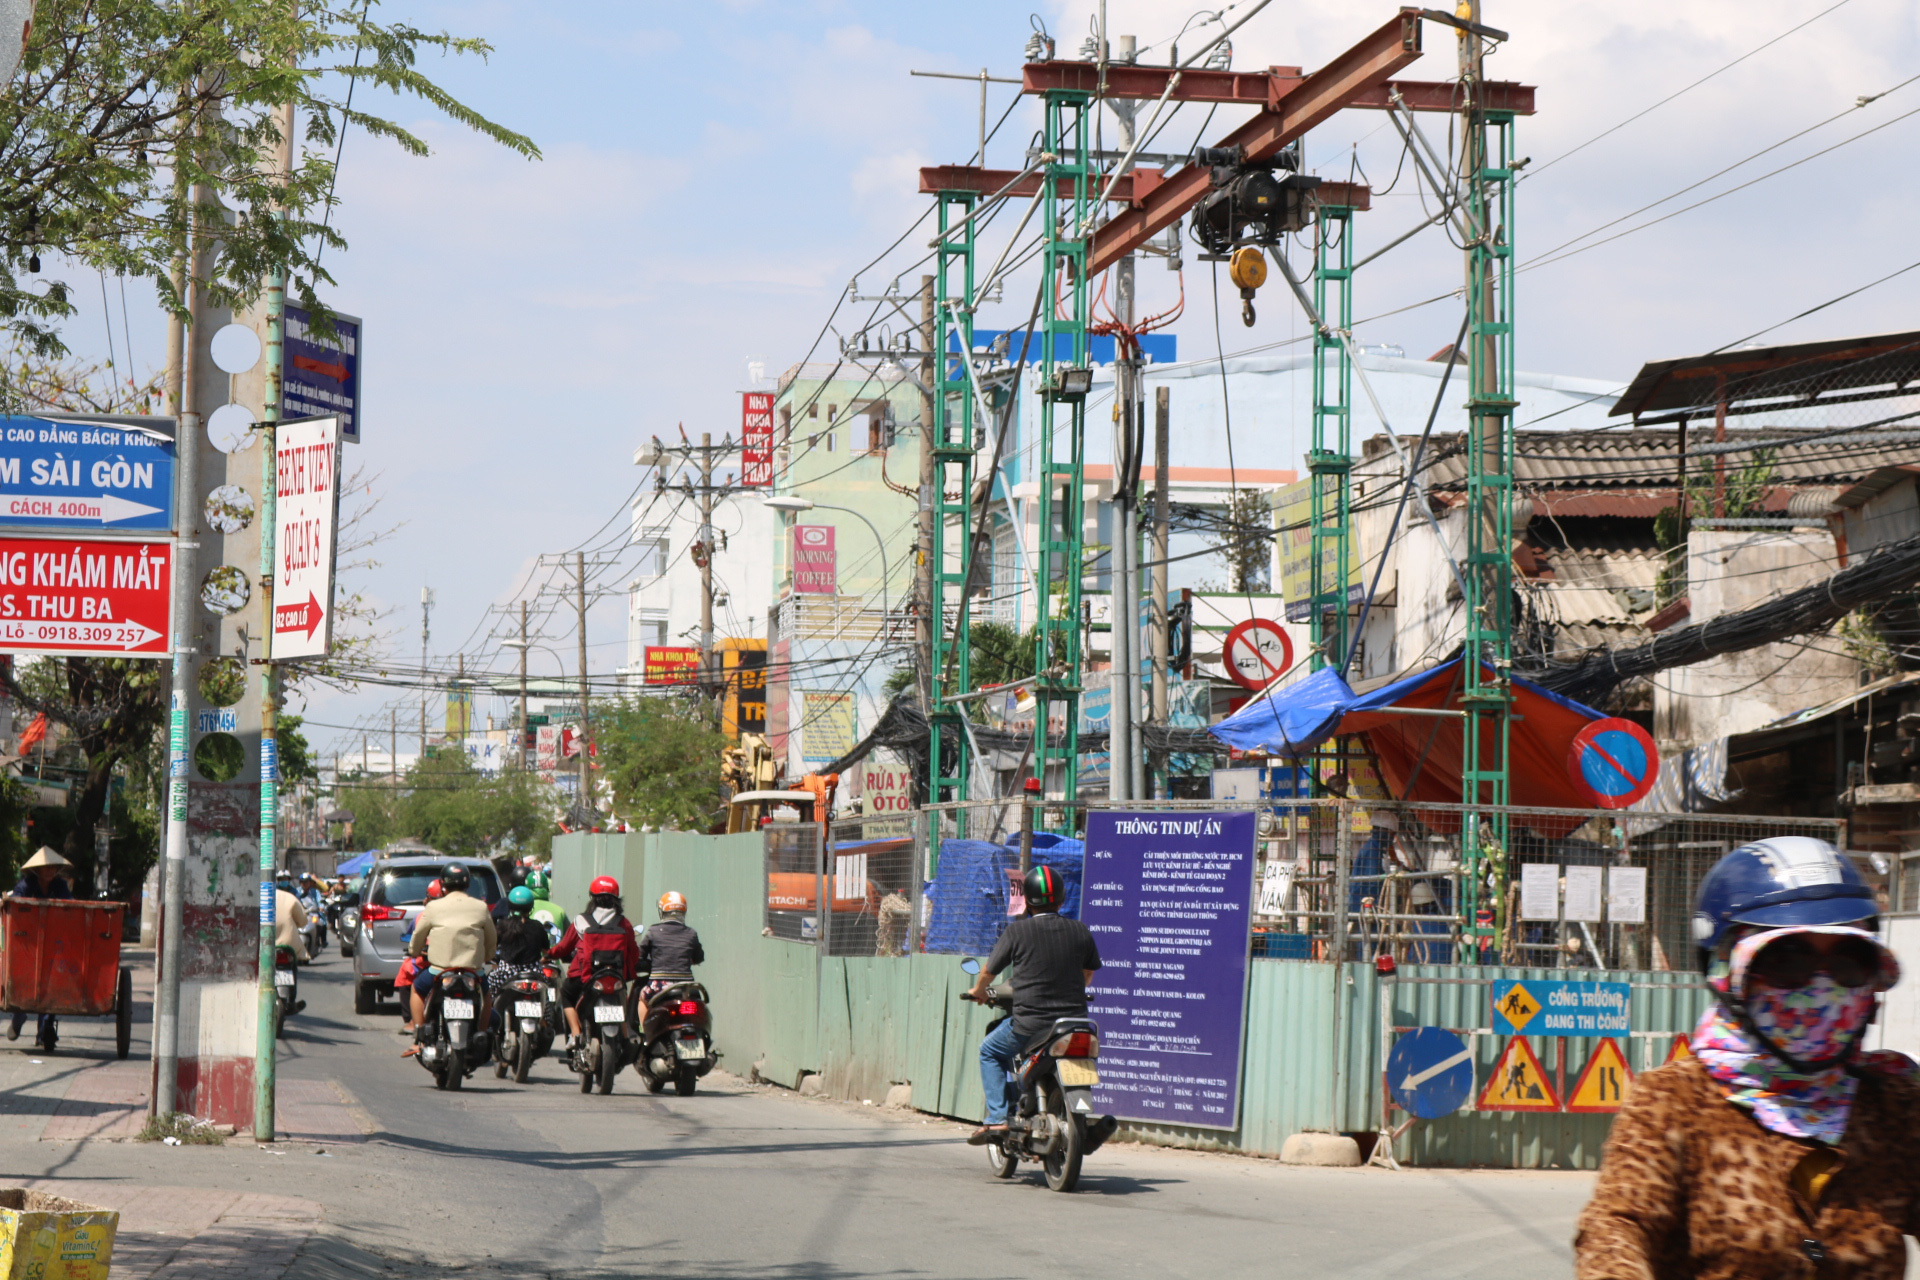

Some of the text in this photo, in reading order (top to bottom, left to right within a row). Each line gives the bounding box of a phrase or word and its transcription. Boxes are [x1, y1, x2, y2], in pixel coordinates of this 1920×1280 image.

[749, 396, 768, 409] NHA
[746, 413, 771, 428] KHOA
[7, 429, 35, 442] CAO
[39, 424, 78, 444] ĐẲNG
[82, 429, 120, 446] BÁCH
[30, 453, 80, 486] SÀI
[91, 454, 153, 489] GÒN
[278, 429, 334, 508] BỆNH VIỆN
[744, 456, 771, 482] PHÁP
[10, 498, 101, 517] CÁCH 400m
[284, 508, 320, 586] QUẬN 8
[796, 550, 833, 563] MORNING
[33, 545, 165, 590] KHÁM MẮT
[796, 571, 833, 585] COFFEE
[27, 595, 75, 618] THU
[82, 597, 112, 620] BA
[276, 613, 284, 627] 82
[286, 611, 298, 626] CAO
[39, 626, 111, 642] 0918.309
[116, 629, 145, 642] 257
[650, 652, 683, 662] NHA KHOA
[867, 766, 894, 790] RỬA
[873, 792, 909, 810] ÔTÔ
[1115, 817, 1222, 838] THÔNG TIN DỰ ÁN
[1548, 988, 1623, 1007] CÔNG TRƯỜNG
[1545, 1013, 1627, 1030] ĐANG THI CÔNG
